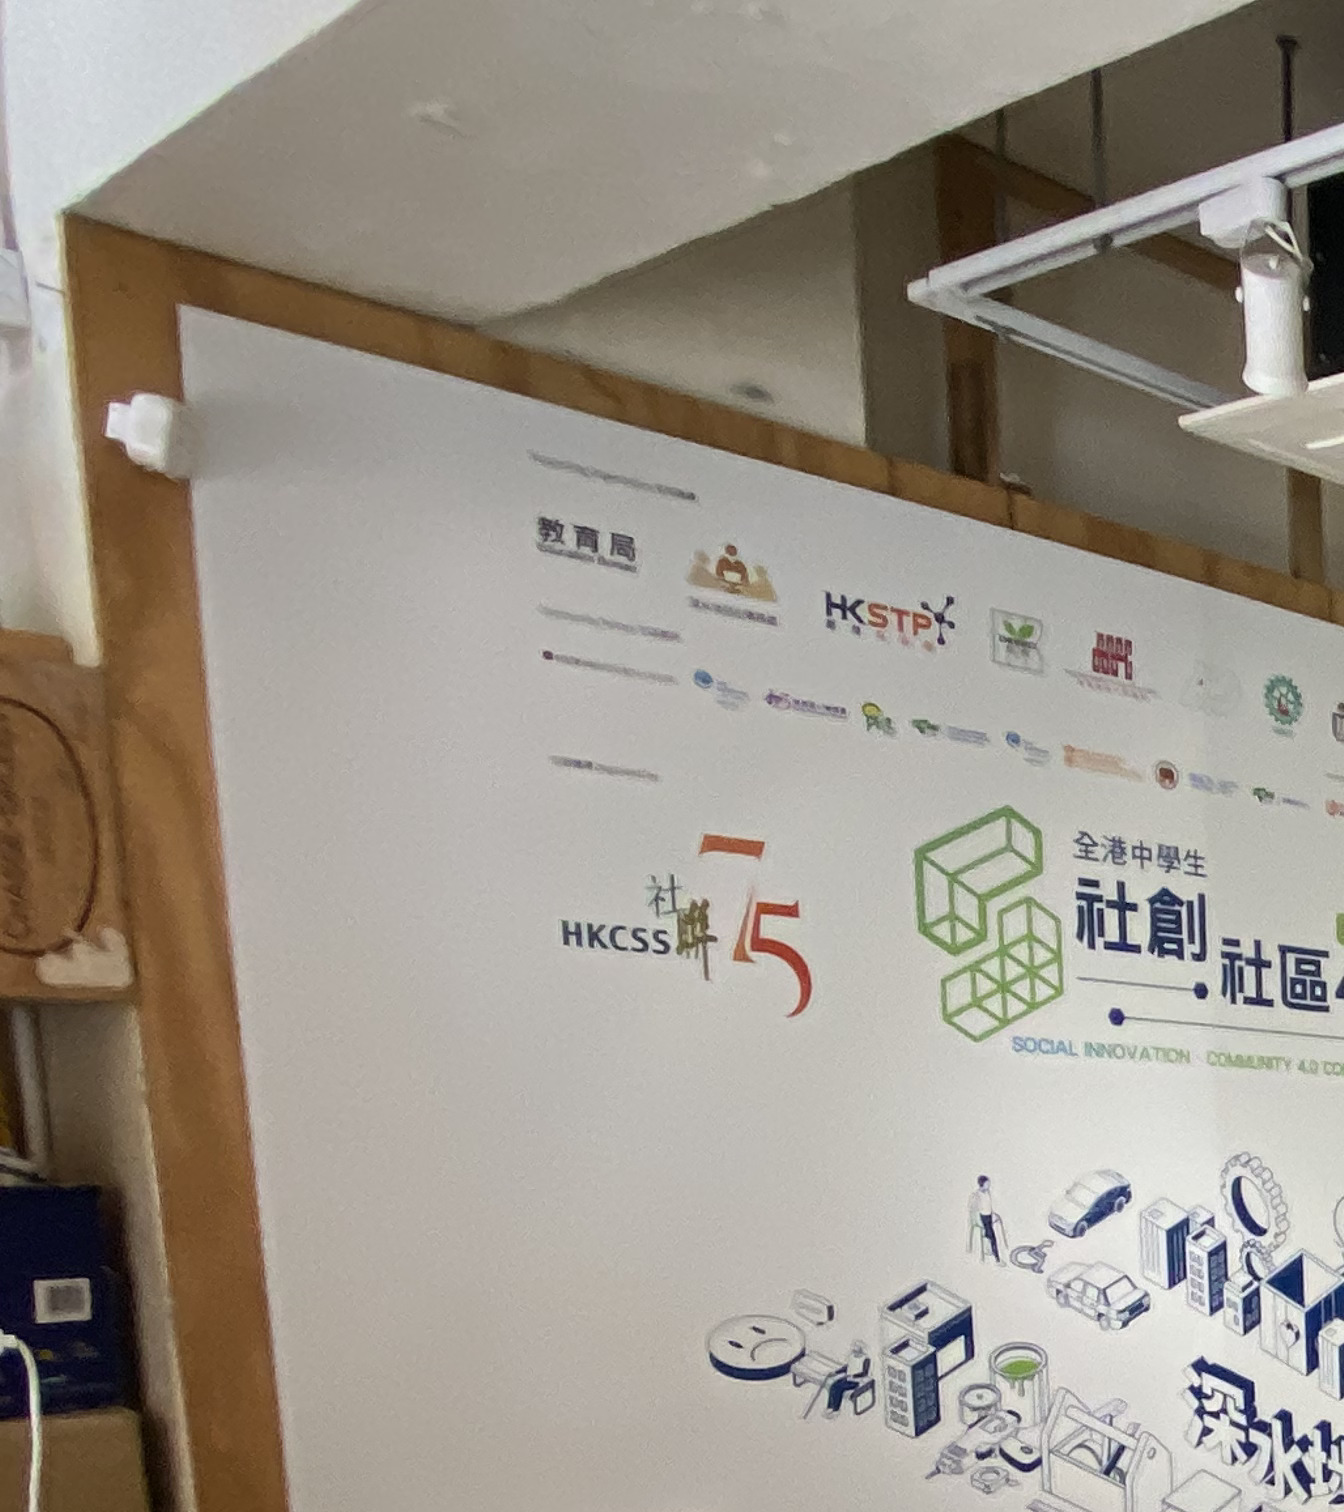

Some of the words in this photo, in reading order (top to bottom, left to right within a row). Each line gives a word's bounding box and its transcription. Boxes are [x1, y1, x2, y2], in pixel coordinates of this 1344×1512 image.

[537, 517, 637, 562] 教育局
[824, 591, 932, 636] HKSTP
[1073, 831, 1207, 877] 全港中學生
[561, 918, 671, 955] HKCSS
[1075, 878, 1207, 962] 社創
[1012, 1037, 1077, 1057] SOCIAL
[1083, 1041, 1191, 1064] INNOVATION
[1206, 1050, 1291, 1073] COMMUNITY
